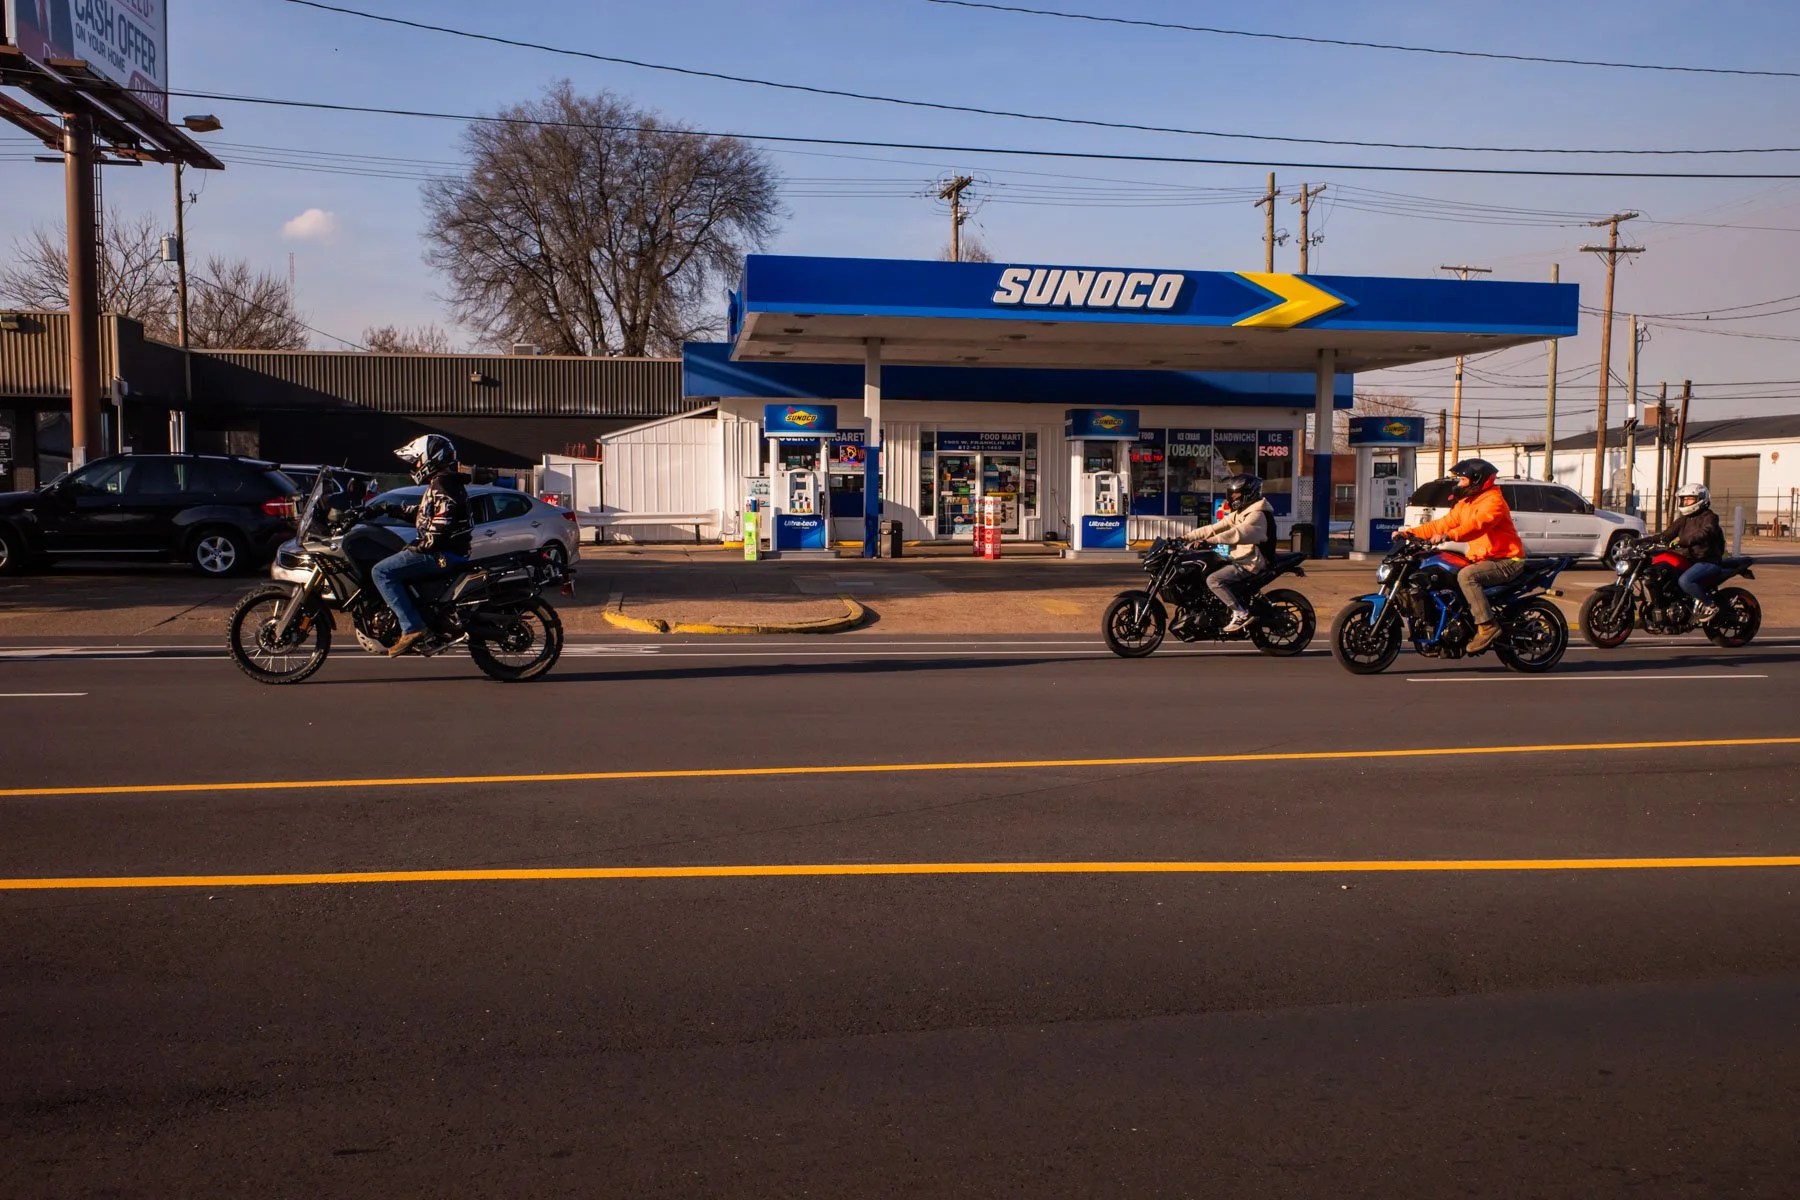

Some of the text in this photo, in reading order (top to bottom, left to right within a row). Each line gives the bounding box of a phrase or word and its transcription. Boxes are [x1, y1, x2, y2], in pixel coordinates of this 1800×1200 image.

[75, 0, 156, 79] CASH OFFER
[75, 22, 86, 43] ON
[88, 31, 106, 58] YOUR
[107, 47, 126, 73] HOME
[134, 76, 165, 114] DAUBY
[992, 267, 1185, 310] SUNOCO
[1001, 433, 1022, 441] MART
[1214, 432, 1256, 442] SANDWICHS
[1268, 433, 1282, 442] ICE
[1167, 443, 1213, 457] TOBACCO
[1258, 445, 1289, 457] E-CIGS
